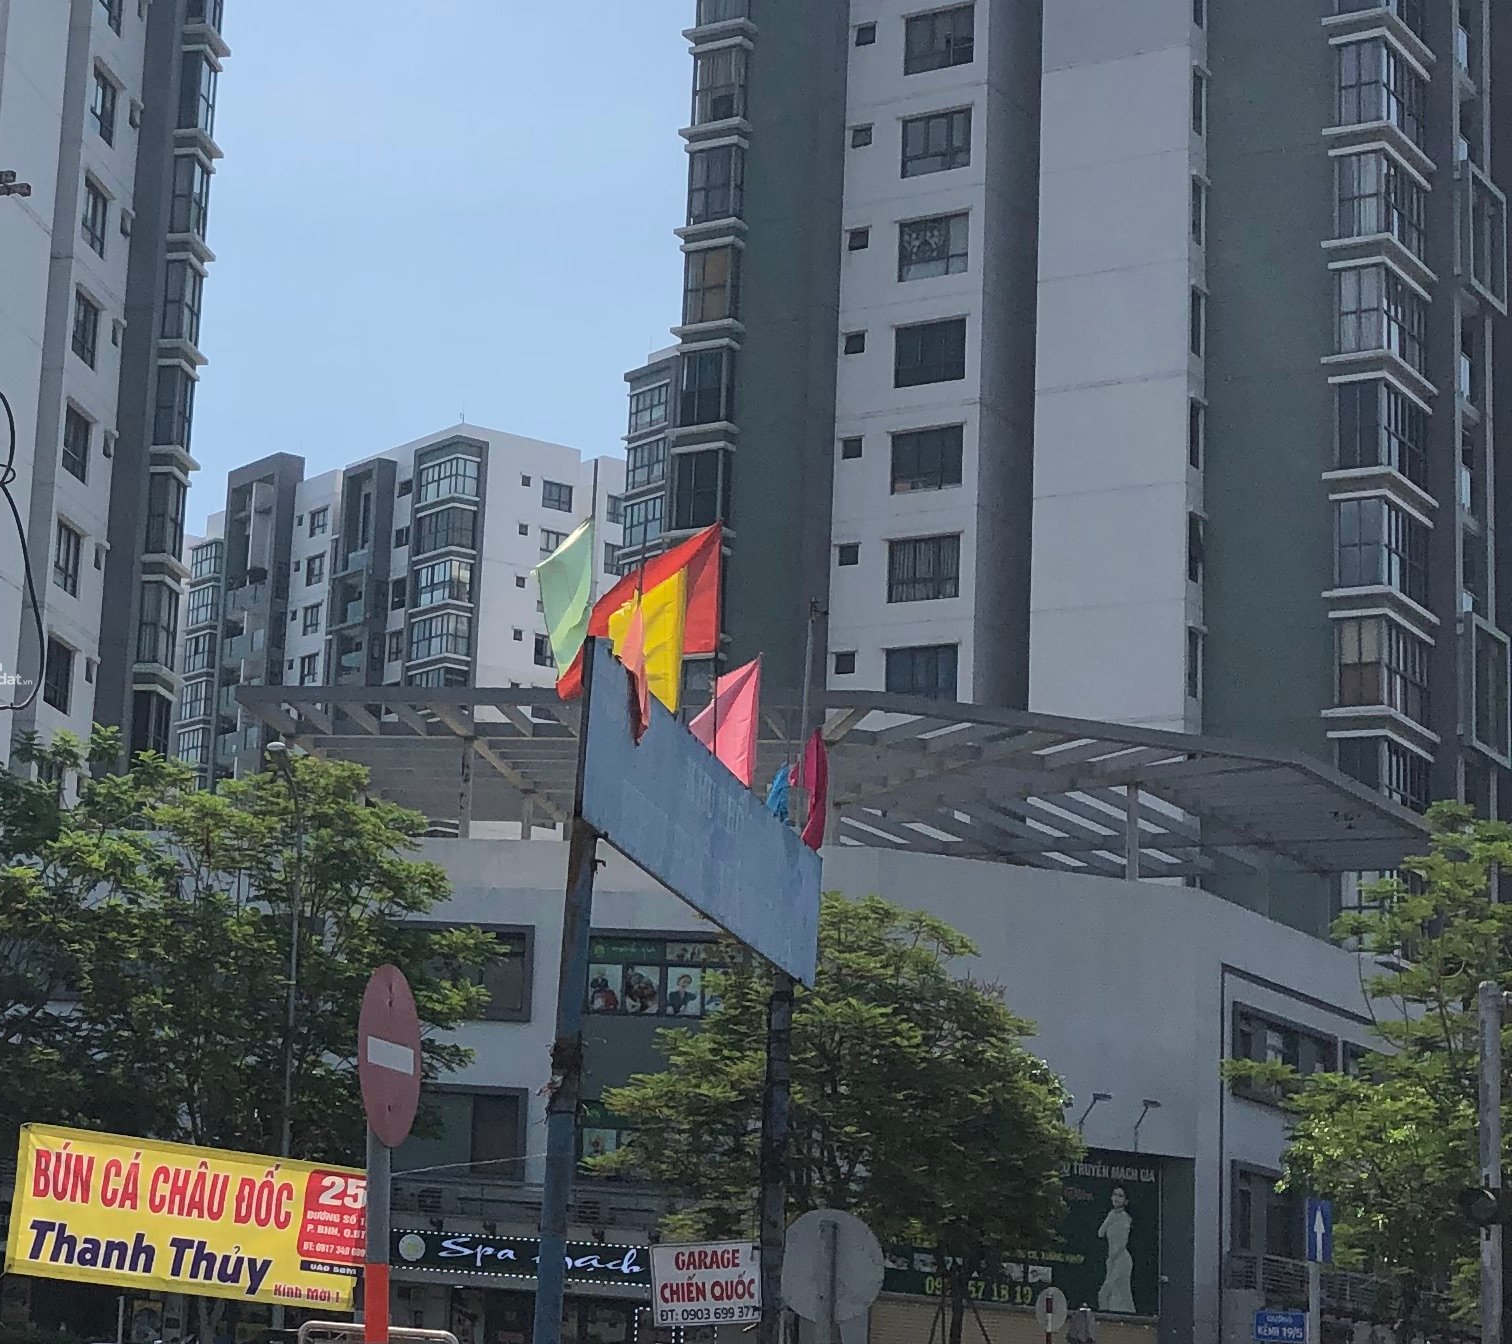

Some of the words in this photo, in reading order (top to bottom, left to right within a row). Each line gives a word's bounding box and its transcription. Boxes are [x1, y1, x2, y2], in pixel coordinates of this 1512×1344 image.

[32, 1142, 95, 1204] BÚN
[100, 1152, 141, 1211] CÁ
[148, 1160, 230, 1222] CHÂU
[233, 1164, 295, 1230] ĐỐC
[319, 1176, 367, 1209] 25
[28, 1219, 156, 1274] Thanh
[169, 1237, 273, 1296] Thủy
[438, 1237, 516, 1266] Spa
[533, 1248, 644, 1274] ạch
[674, 1249, 740, 1270] GARAGE
[660, 1273, 707, 1304] CHIẾN
[710, 1270, 756, 1302] QUỐC
[660, 1309, 679, 1321] ĐT:
[681, 1308, 710, 1320] 0903
[714, 1307, 735, 1319] 699
[1282, 1327, 1303, 1338] 19/5
